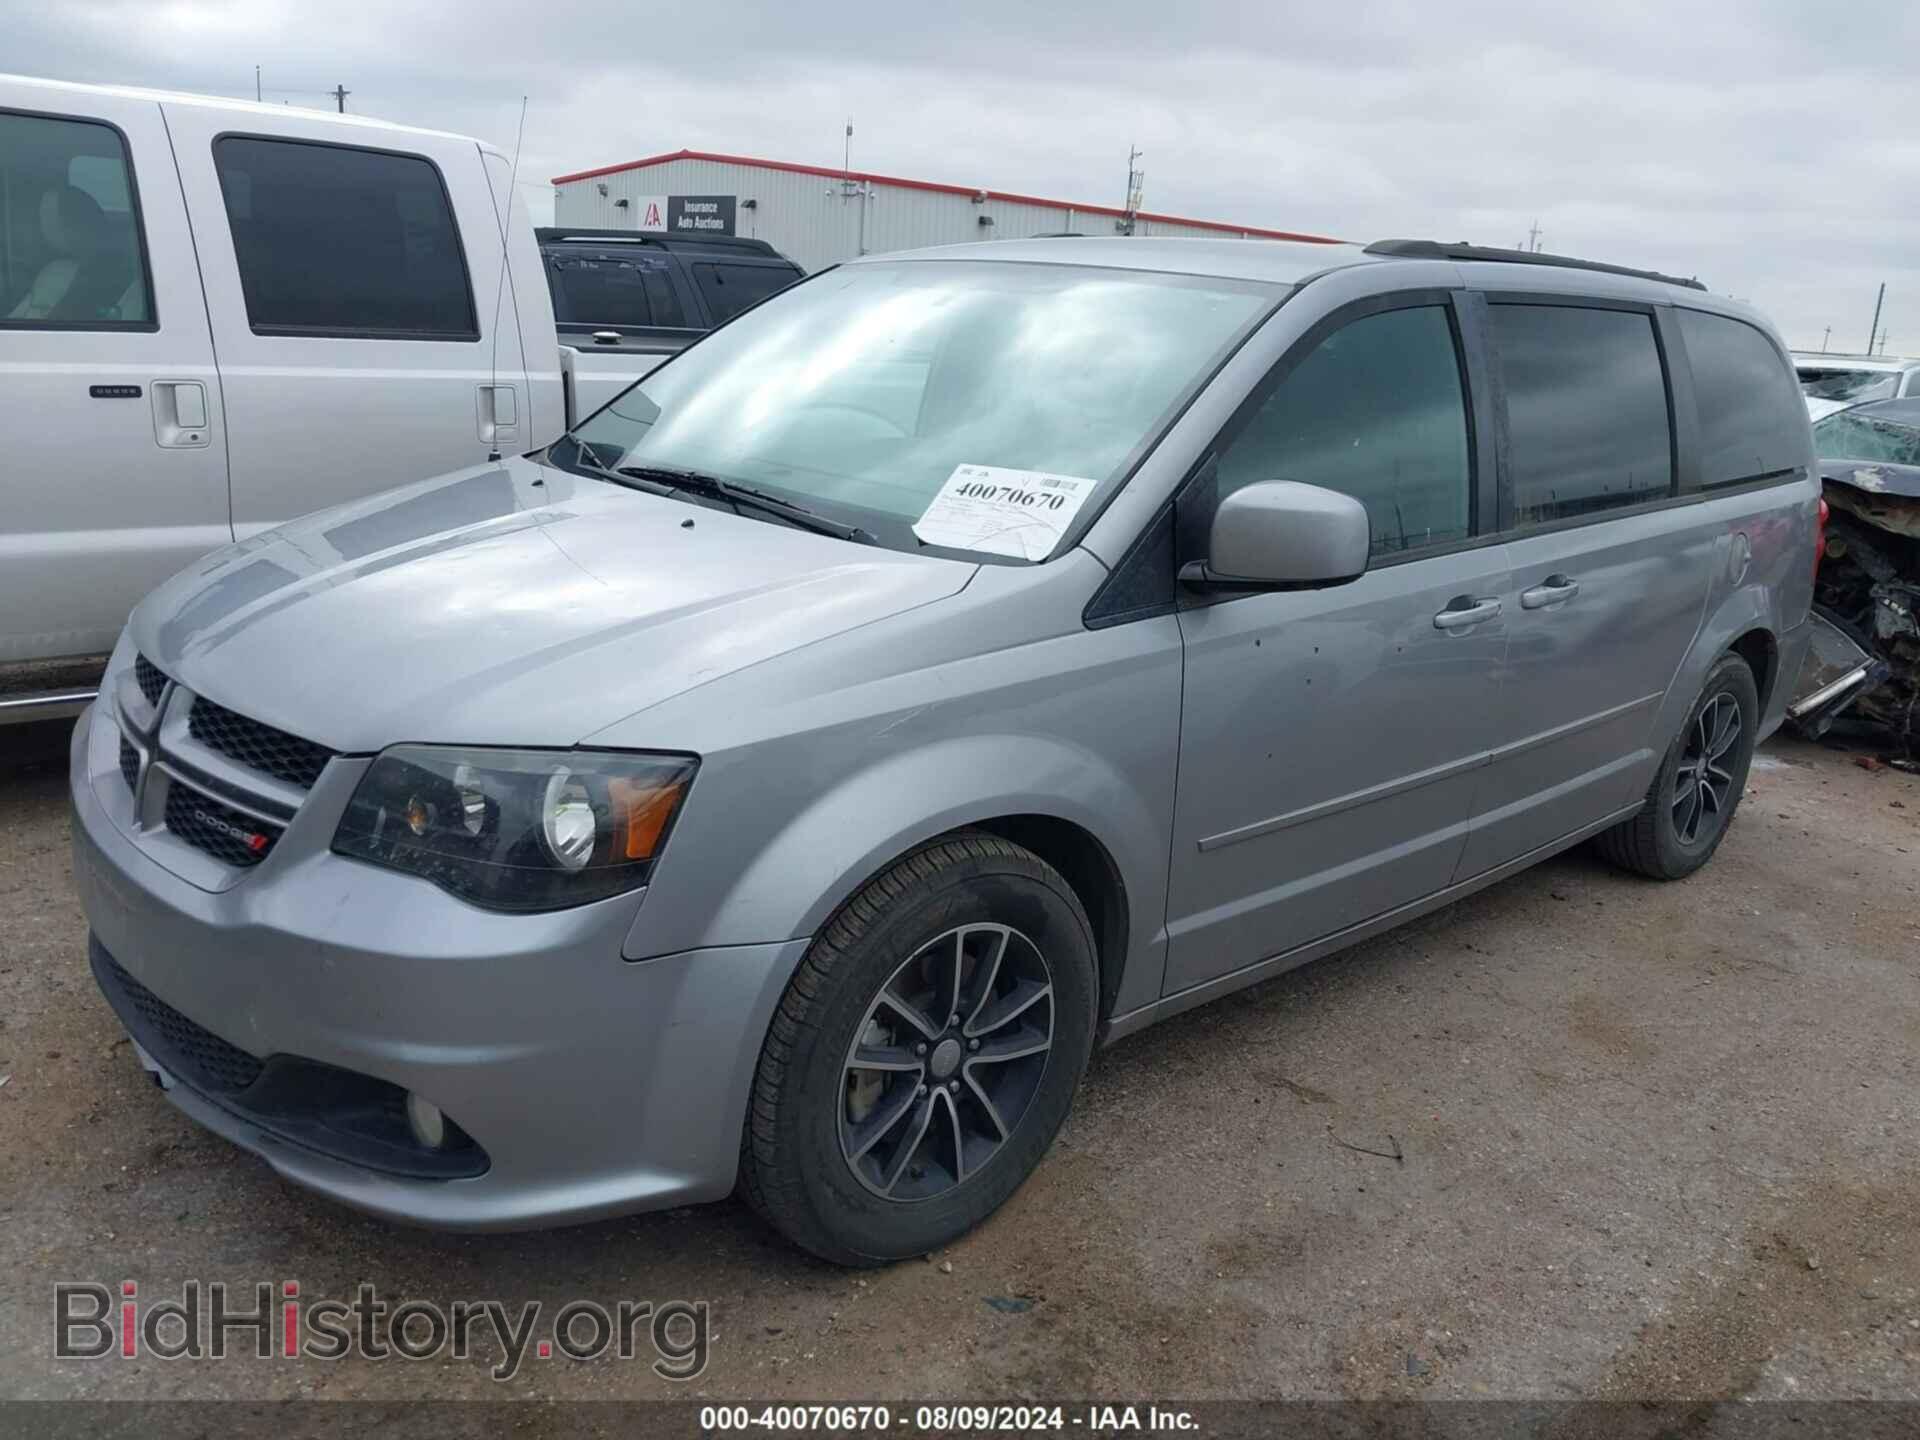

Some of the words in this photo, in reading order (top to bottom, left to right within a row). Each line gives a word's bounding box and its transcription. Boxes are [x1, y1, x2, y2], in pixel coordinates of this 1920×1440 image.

[684, 200, 718, 213] Insurance
[677, 215, 693, 229] Auto
[694, 215, 724, 229] Auctions
[955, 482, 1065, 510] 40070670
[194, 809, 254, 843] DODGE
